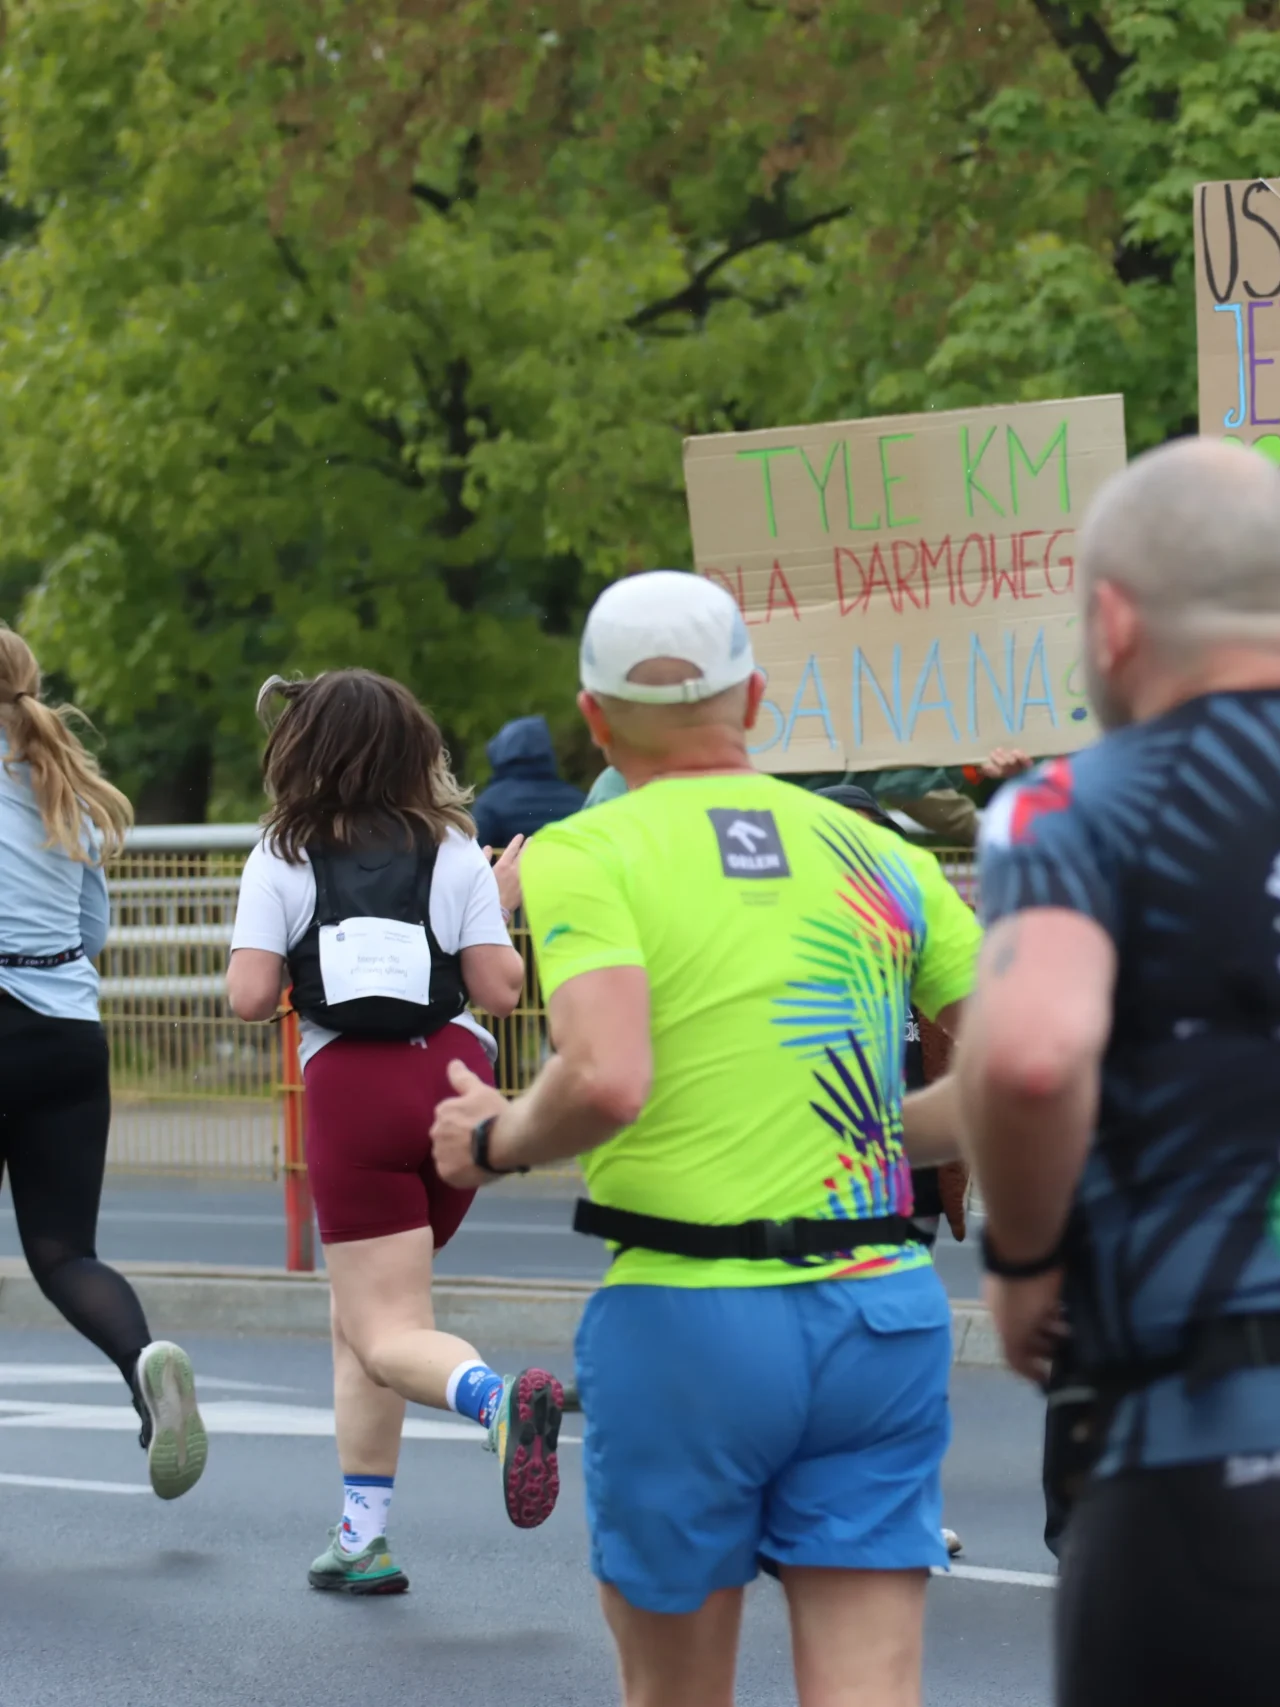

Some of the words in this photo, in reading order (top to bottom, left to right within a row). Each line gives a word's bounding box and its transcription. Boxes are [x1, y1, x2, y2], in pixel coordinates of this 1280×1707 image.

[736, 433, 921, 539] TYLE
[959, 418, 1072, 518] KM
[834, 528, 1077, 618] DARMOWEG
